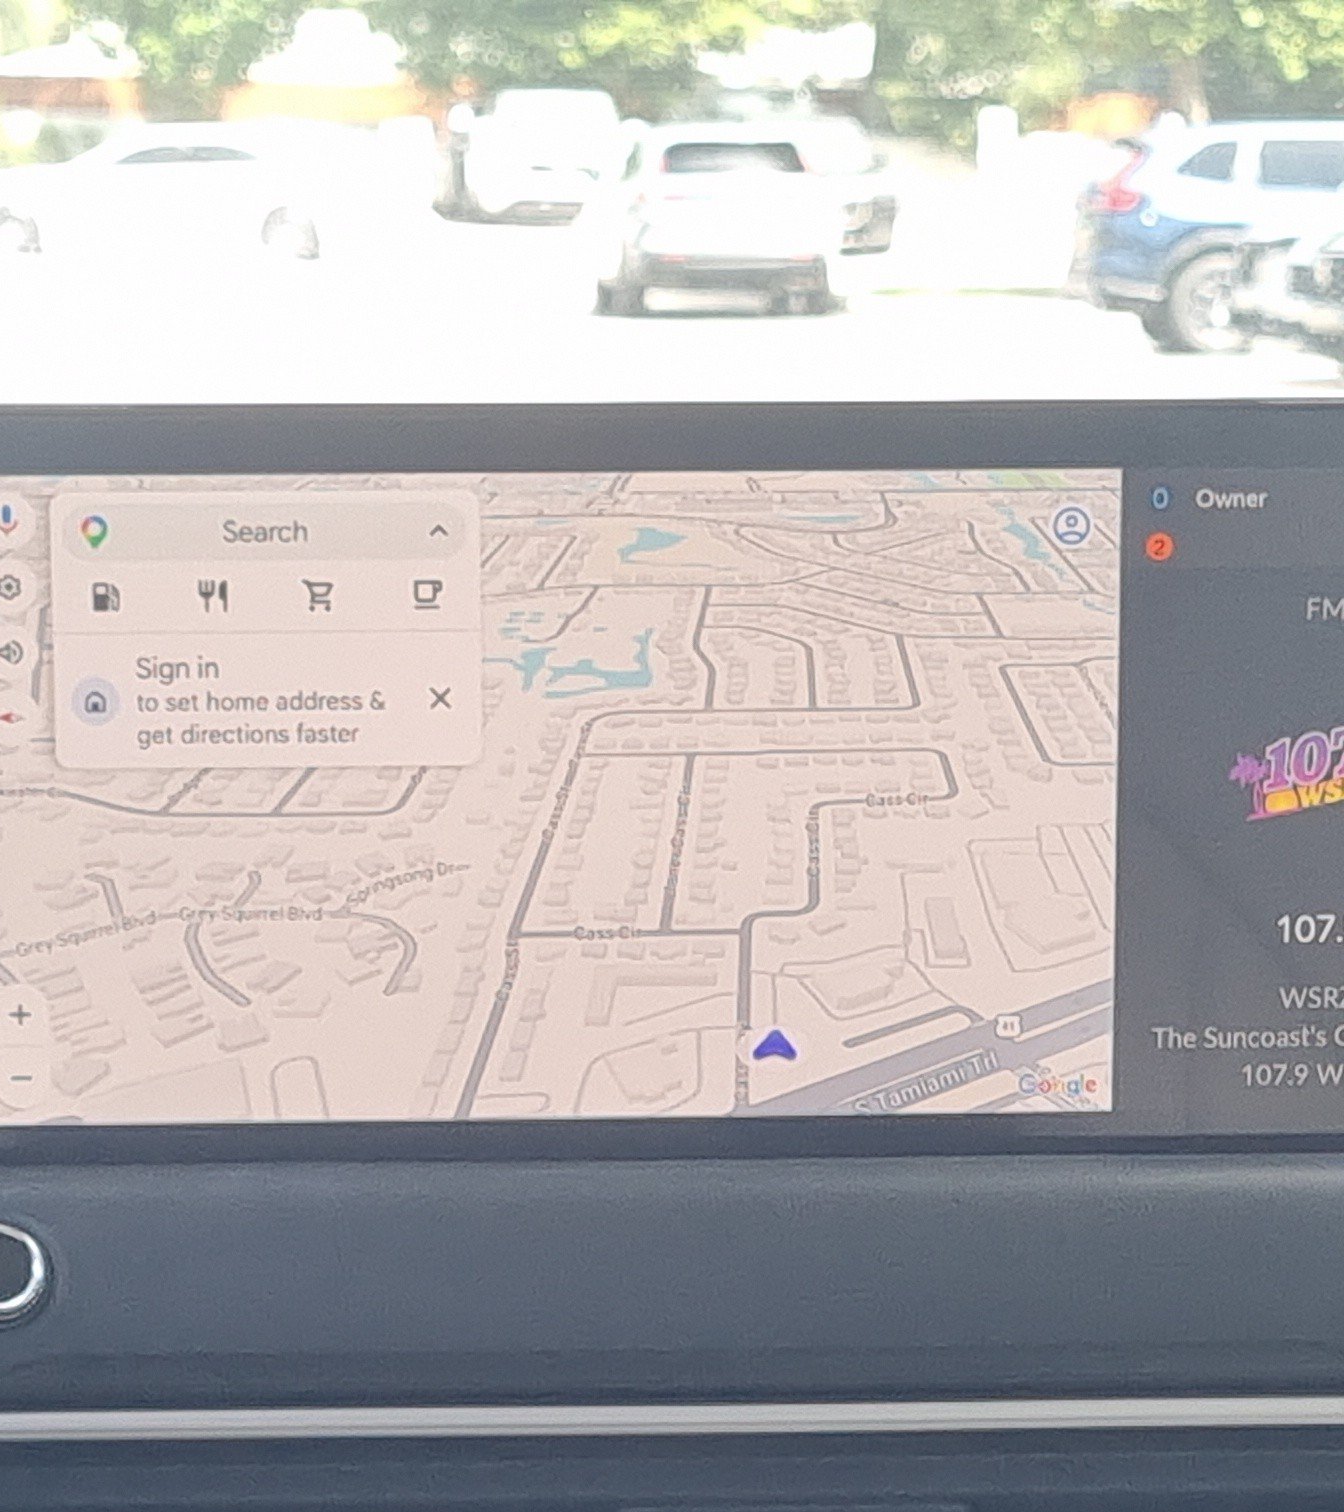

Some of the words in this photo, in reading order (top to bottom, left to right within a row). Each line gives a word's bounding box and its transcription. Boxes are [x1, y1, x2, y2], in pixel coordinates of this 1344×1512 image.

[1196, 488, 1268, 508] Owner
[223, 520, 308, 543] Search
[136, 657, 194, 685] Sign
[200, 657, 219, 679] in
[137, 692, 157, 711] to
[164, 692, 198, 712] set
[206, 690, 269, 711] home
[276, 689, 363, 712] address
[370, 690, 386, 711] &
[137, 724, 174, 746] get
[181, 722, 289, 745] directions
[295, 722, 359, 745] faster
[1153, 1027, 1198, 1049] The
[1203, 1025, 1328, 1049] Suncoast's
[1018, 1073, 1097, 1098] Google
[1241, 1064, 1308, 1087] 107.9
[876, 1067, 966, 1110] Tamiami
